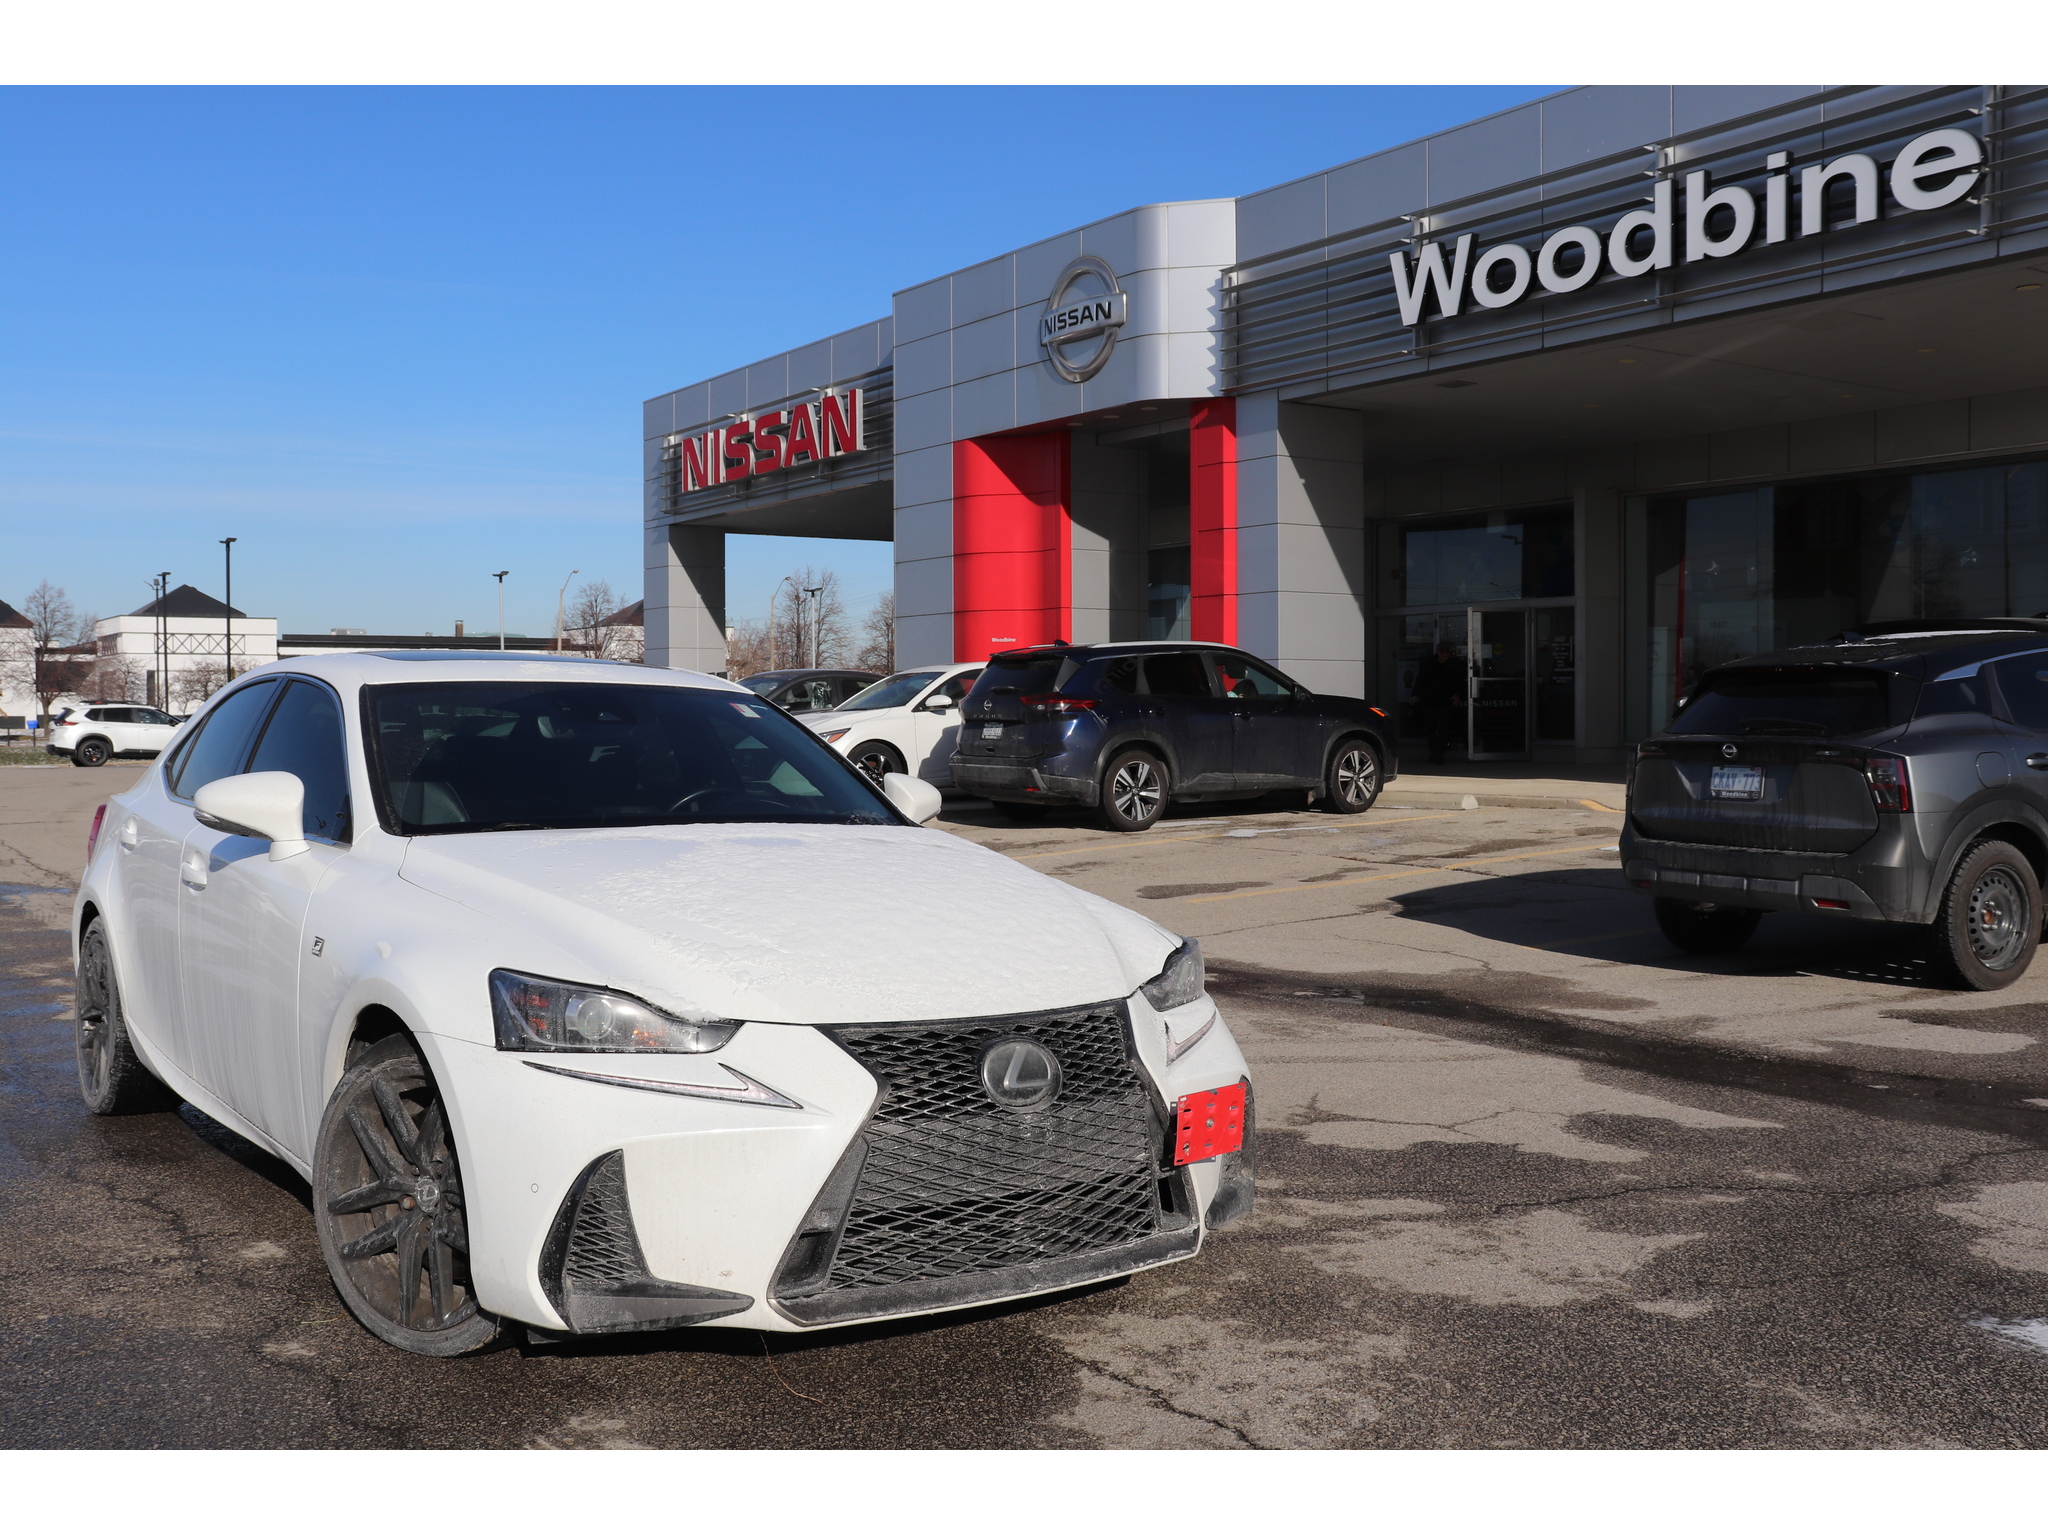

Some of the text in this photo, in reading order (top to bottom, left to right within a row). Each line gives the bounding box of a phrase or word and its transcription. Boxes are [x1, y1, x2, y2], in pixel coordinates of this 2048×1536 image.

[1389, 127, 1985, 328] Woodbine
[1044, 301, 1112, 338] NISSAN
[682, 388, 864, 493] NISSAN
[1482, 699, 1518, 707] NISSAN
